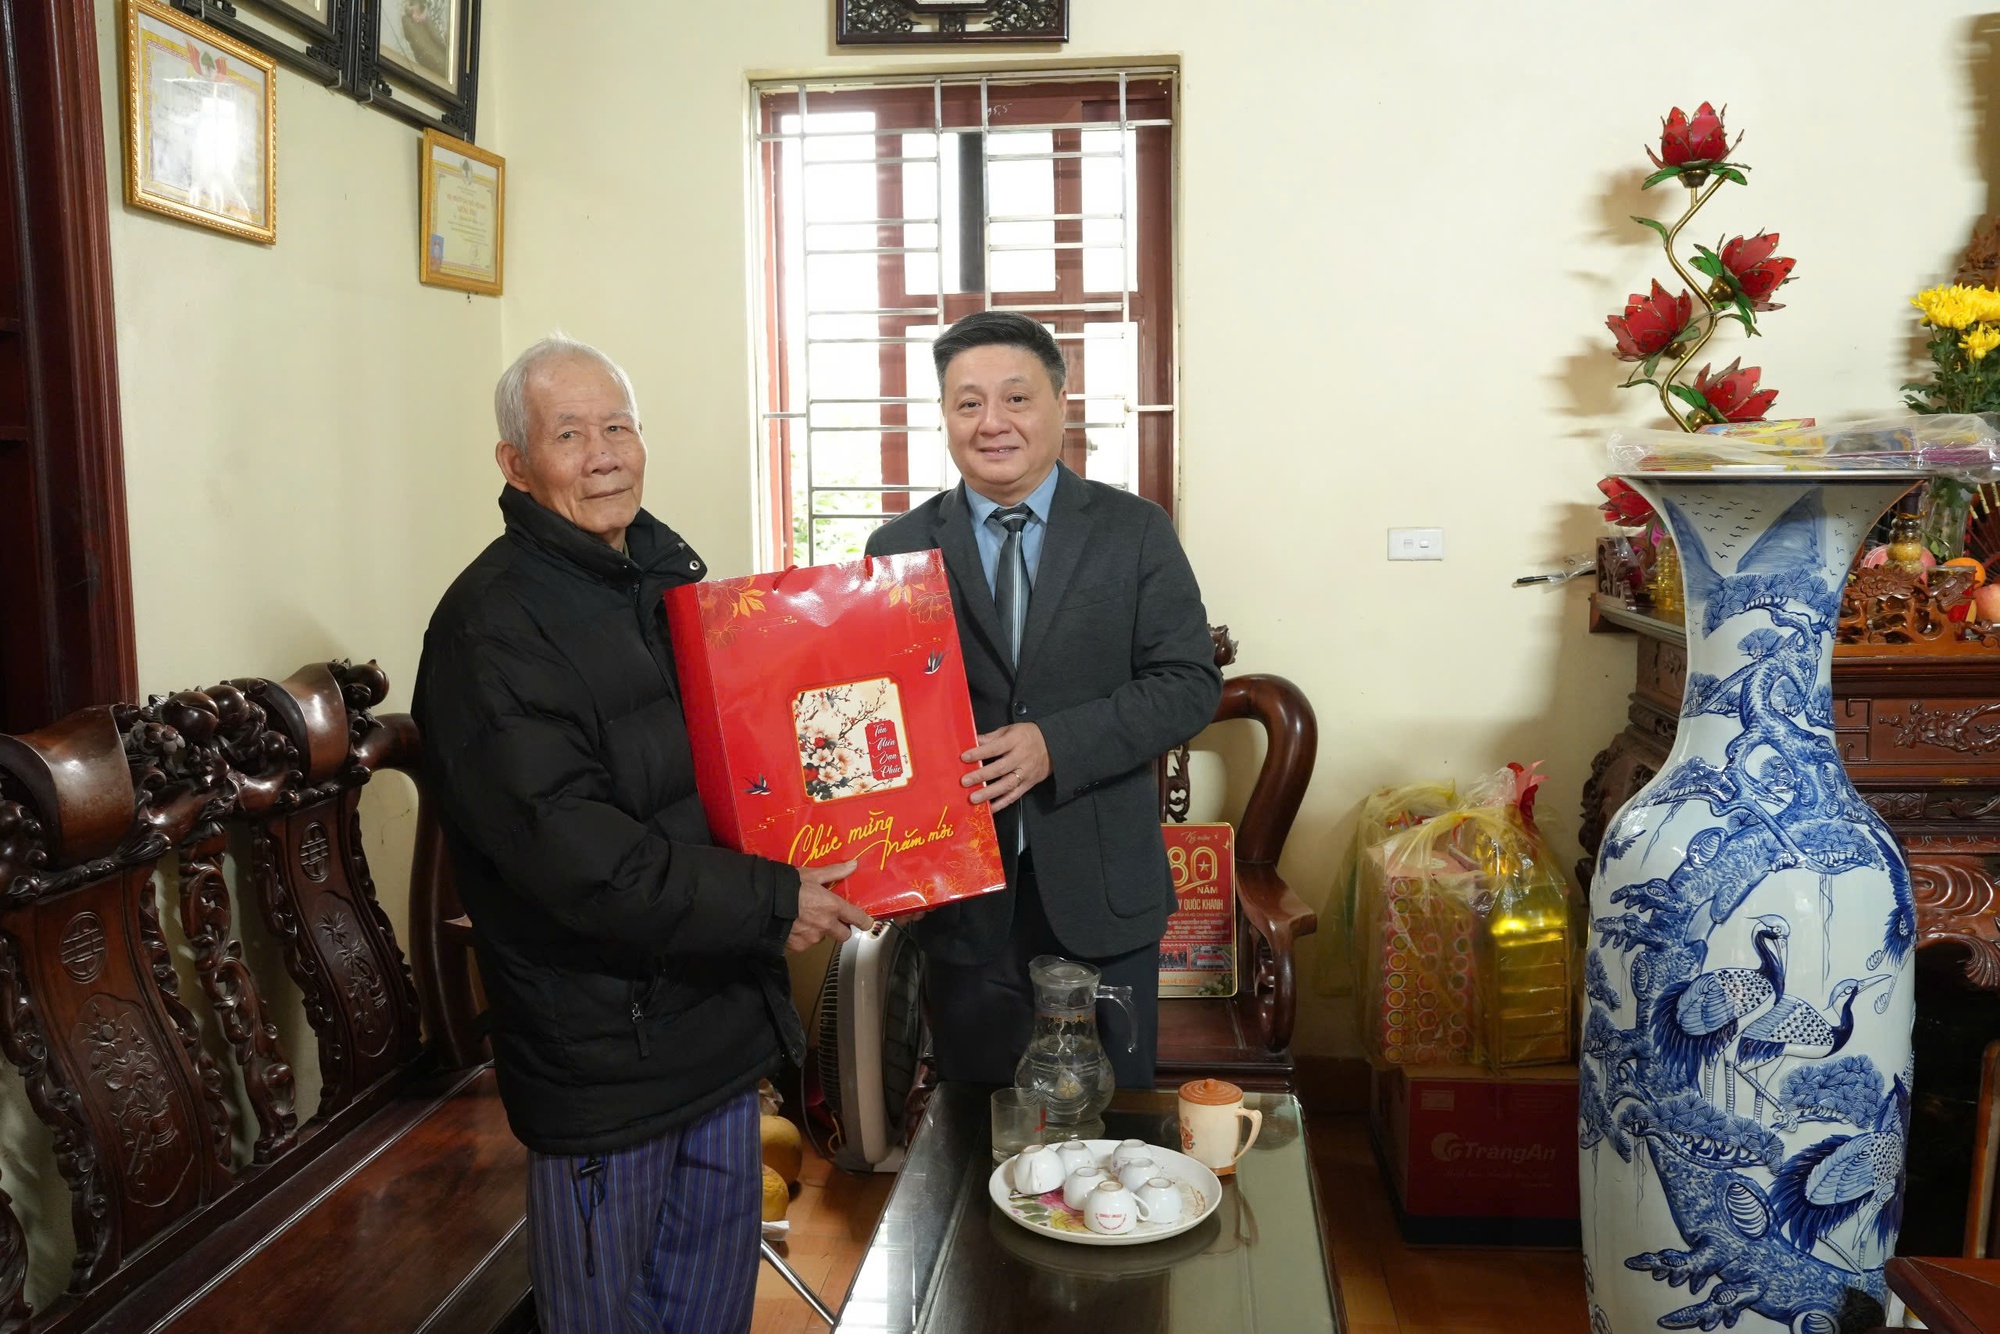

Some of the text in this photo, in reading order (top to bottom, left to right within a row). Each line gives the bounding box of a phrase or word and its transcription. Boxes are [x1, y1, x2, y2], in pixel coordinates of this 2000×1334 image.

[927, 805, 954, 842] mới
[788, 824, 842, 867] Chúc
[1167, 846, 1218, 890] 80
[1197, 885, 1218, 894] NĂM
